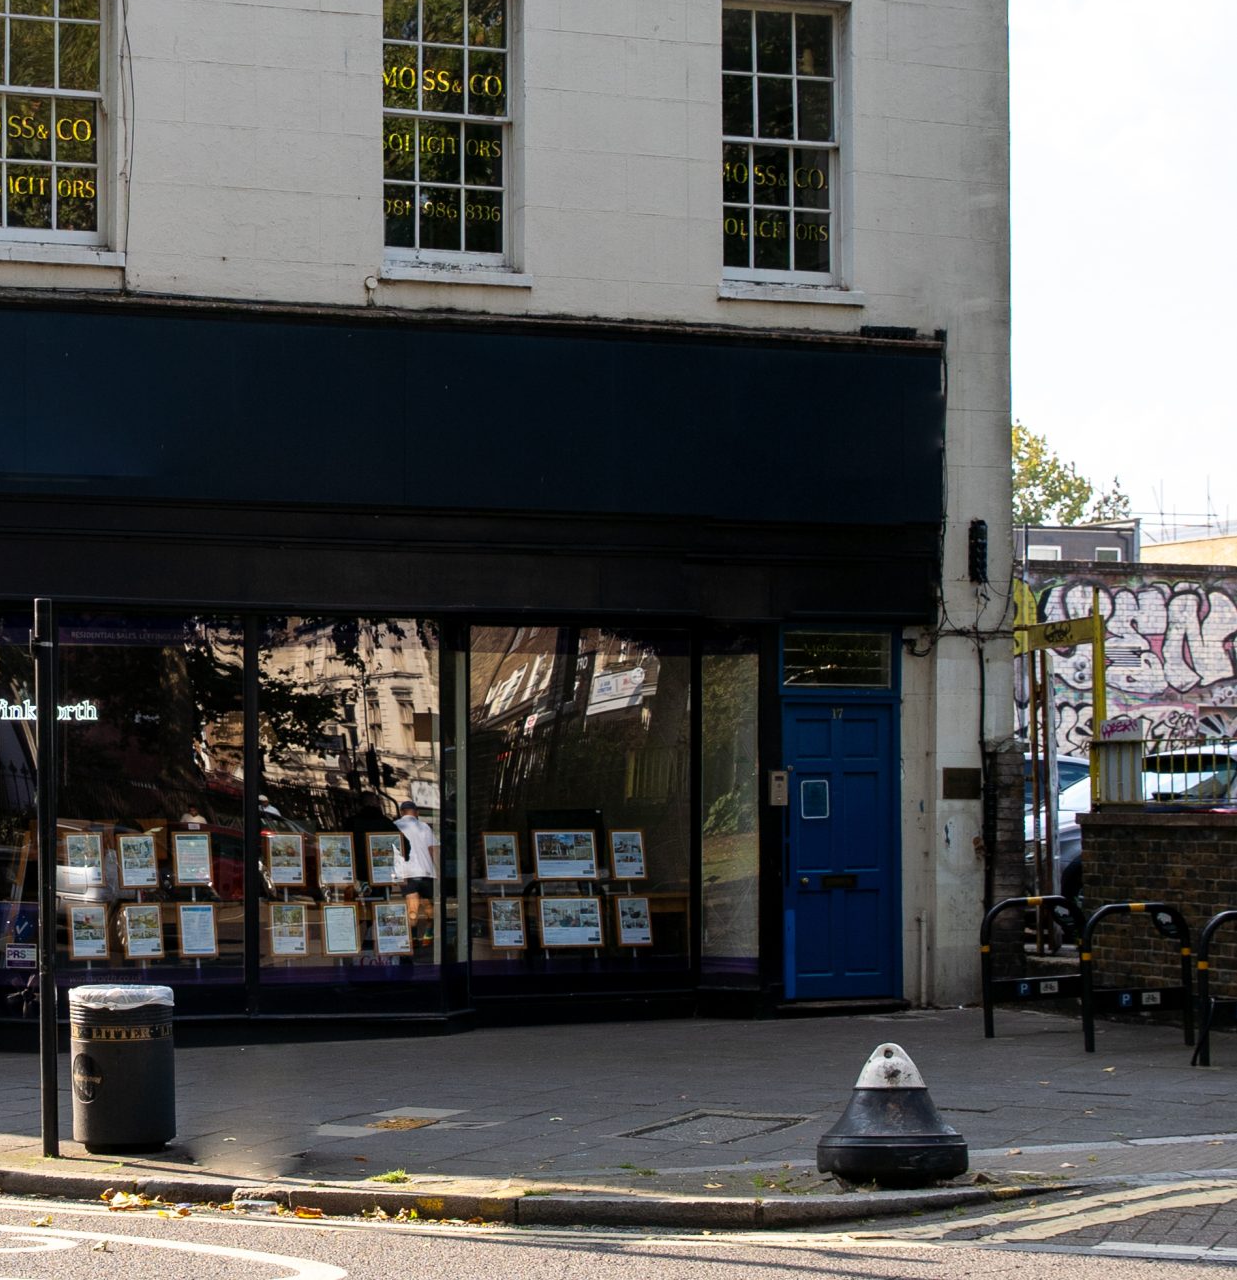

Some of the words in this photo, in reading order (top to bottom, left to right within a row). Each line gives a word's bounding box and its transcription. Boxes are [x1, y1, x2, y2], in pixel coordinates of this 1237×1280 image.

[723, 217, 829, 242] OLICITORS
[831, 707, 844, 720] 17
[7, 949, 27, 959] PRS
[92, 1027, 151, 1040] LITTER
